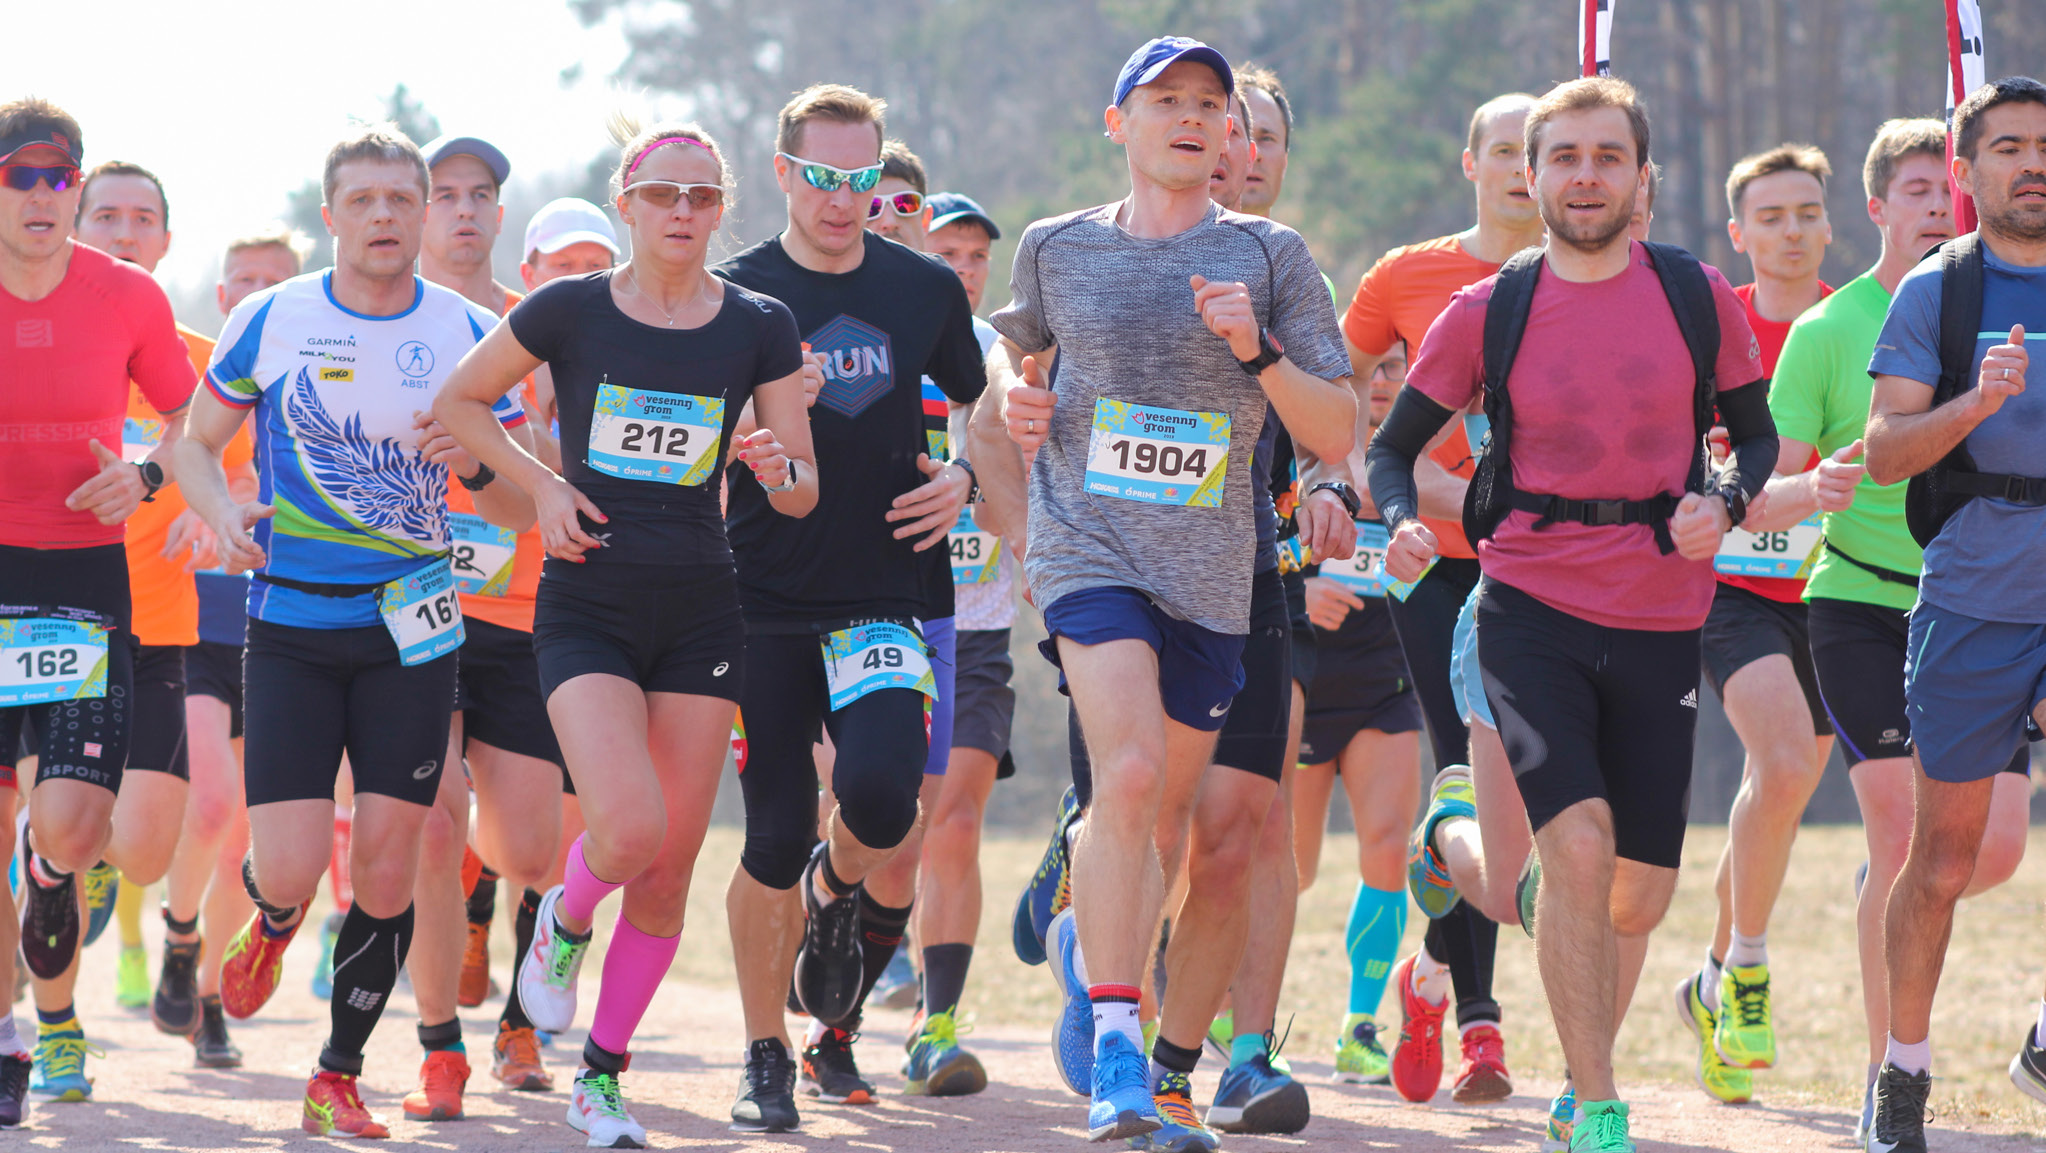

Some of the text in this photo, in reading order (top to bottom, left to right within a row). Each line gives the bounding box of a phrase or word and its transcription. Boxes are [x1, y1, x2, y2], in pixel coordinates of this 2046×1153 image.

[307, 337, 356, 347] GARMIN
[299, 350, 356, 363] MILK2YOU
[324, 369, 349, 380] TOKO
[401, 379, 429, 389] ABST
[644, 405, 672, 415] grom
[1144, 422, 1175, 434] grom
[621, 423, 689, 457] 212
[1111, 440, 1207, 478] 1904
[950, 537, 980, 560] 43
[1752, 531, 1789, 552] 36
[31, 631, 58, 642] grom
[17, 648, 78, 678] 162
[863, 647, 903, 669] 49
[43, 764, 111, 784] SSPORT
